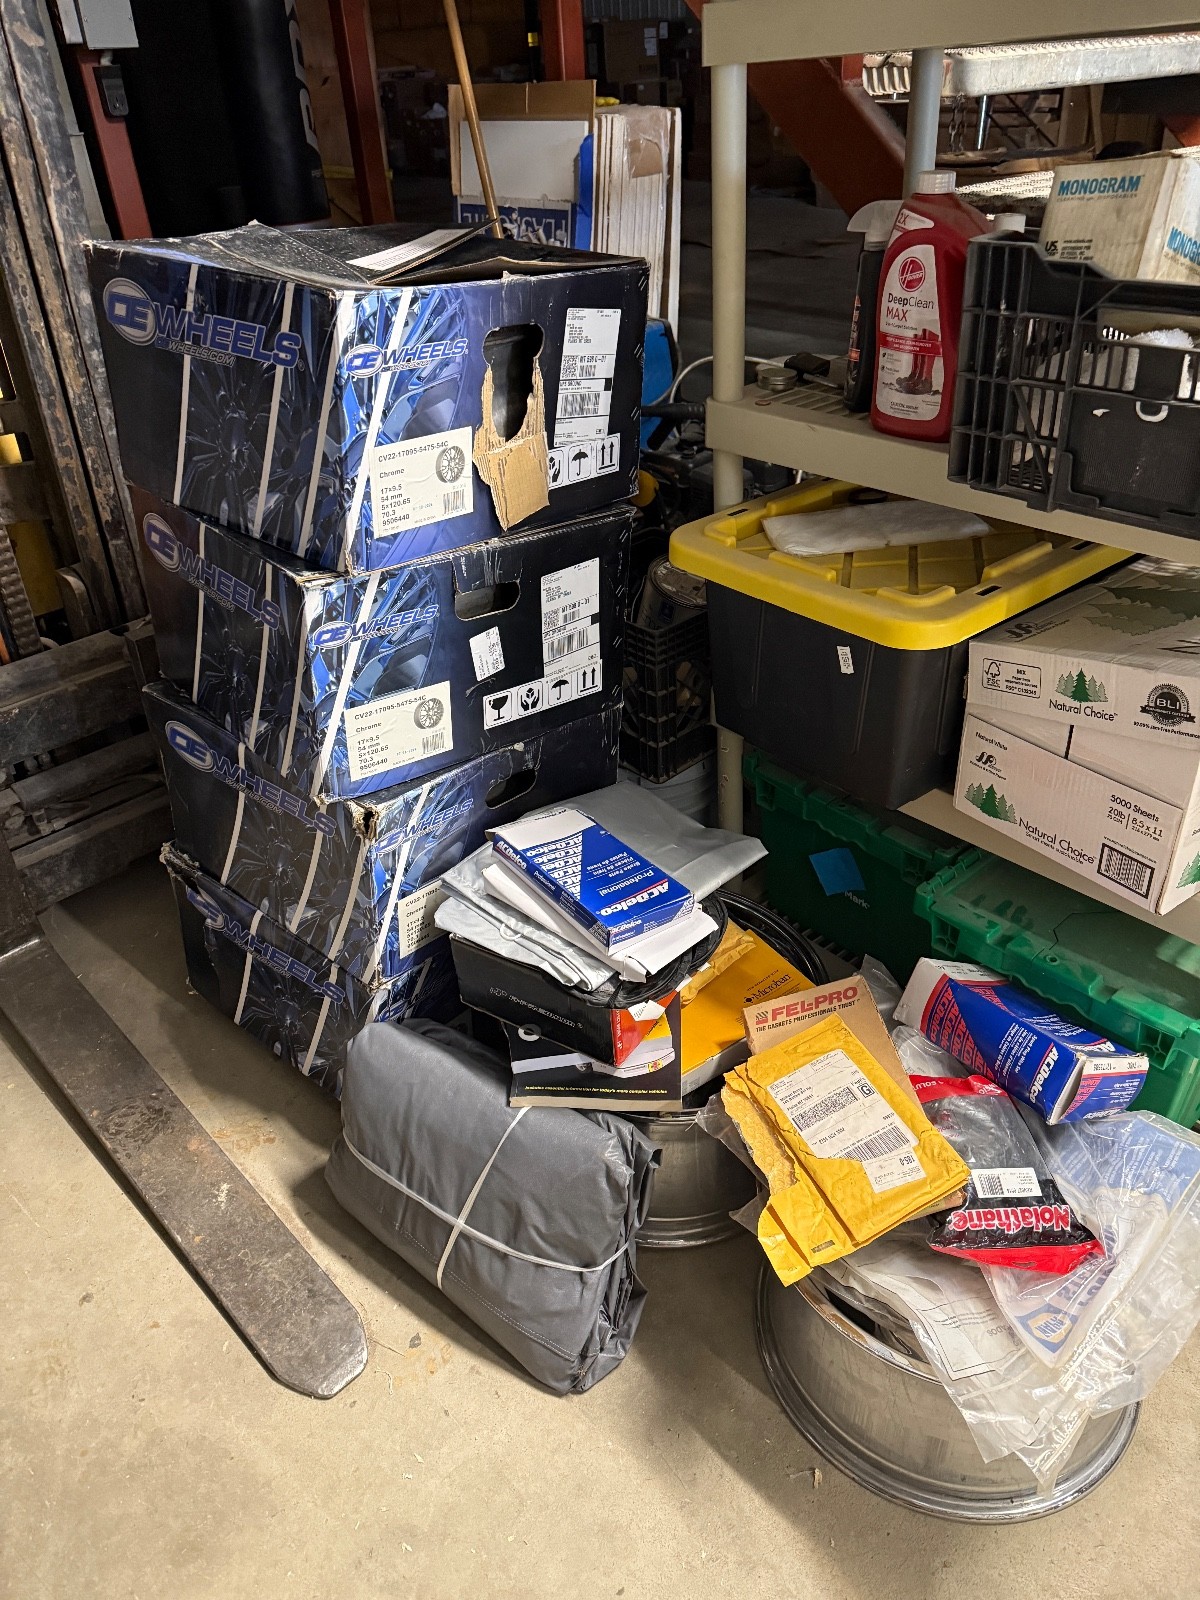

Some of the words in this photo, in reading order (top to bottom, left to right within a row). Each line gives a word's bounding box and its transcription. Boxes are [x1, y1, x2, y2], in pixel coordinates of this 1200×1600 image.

[1057, 175, 1142, 196] MONOGRAM
[886, 306, 909, 322] MAX
[887, 293, 935, 310] DeepClean
[107, 290, 150, 333] OE
[154, 302, 302, 369] WHEELS
[347, 353, 382, 373] OE
[383, 339, 468, 366] WHEELS
[378, 440, 449, 463] CV22-17095-5475-54C
[379, 467, 405, 480] Chrome
[382, 509, 396, 519] 70.3
[382, 513, 410, 526] 9506440
[177, 541, 281, 630] WHEELS
[314, 627, 350, 646] OE
[351, 604, 439, 637] WHEELS
[987, 677, 1000, 685] FSC
[354, 694, 427, 721] CV22-17095-5475-54C
[1049, 698, 1081, 715] Natural
[1083, 706, 1115, 721] Choice
[1156, 698, 1180, 710] BLI
[355, 722, 382, 733] Chrome
[370, 741, 381, 749] mm
[359, 755, 374, 765] 70.3
[359, 757, 388, 772] 9506440
[211, 750, 337, 838] WHEELS
[400, 798, 474, 839] WHEELS
[1108, 806, 1126, 820] 20lb
[1110, 794, 1132, 810] 5000
[1132, 804, 1160, 822] Sheets
[1018, 816, 1057, 845] Natural
[1059, 839, 1095, 864] Choice
[1131, 817, 1145, 829] 8.5
[1152, 826, 1163, 838] 11
[497, 841, 528, 870] ACDelco
[526, 836, 583, 857] ACDelco
[599, 869, 655, 897] Professional
[599, 882, 671, 917] ACDelco
[224, 914, 346, 1004] WHEELS
[753, 972, 792, 1001] Microban
[755, 1025, 767, 1033] THE
[767, 1019, 792, 1031] GASKETS
[793, 1005, 837, 1023] PROFESSIONALS
[837, 1001, 856, 1012] TRUST
[930, 988, 952, 1041] ACDelco
[1029, 1046, 1059, 1103] ACDelco
[950, 1204, 1071, 1233] Nolathane
